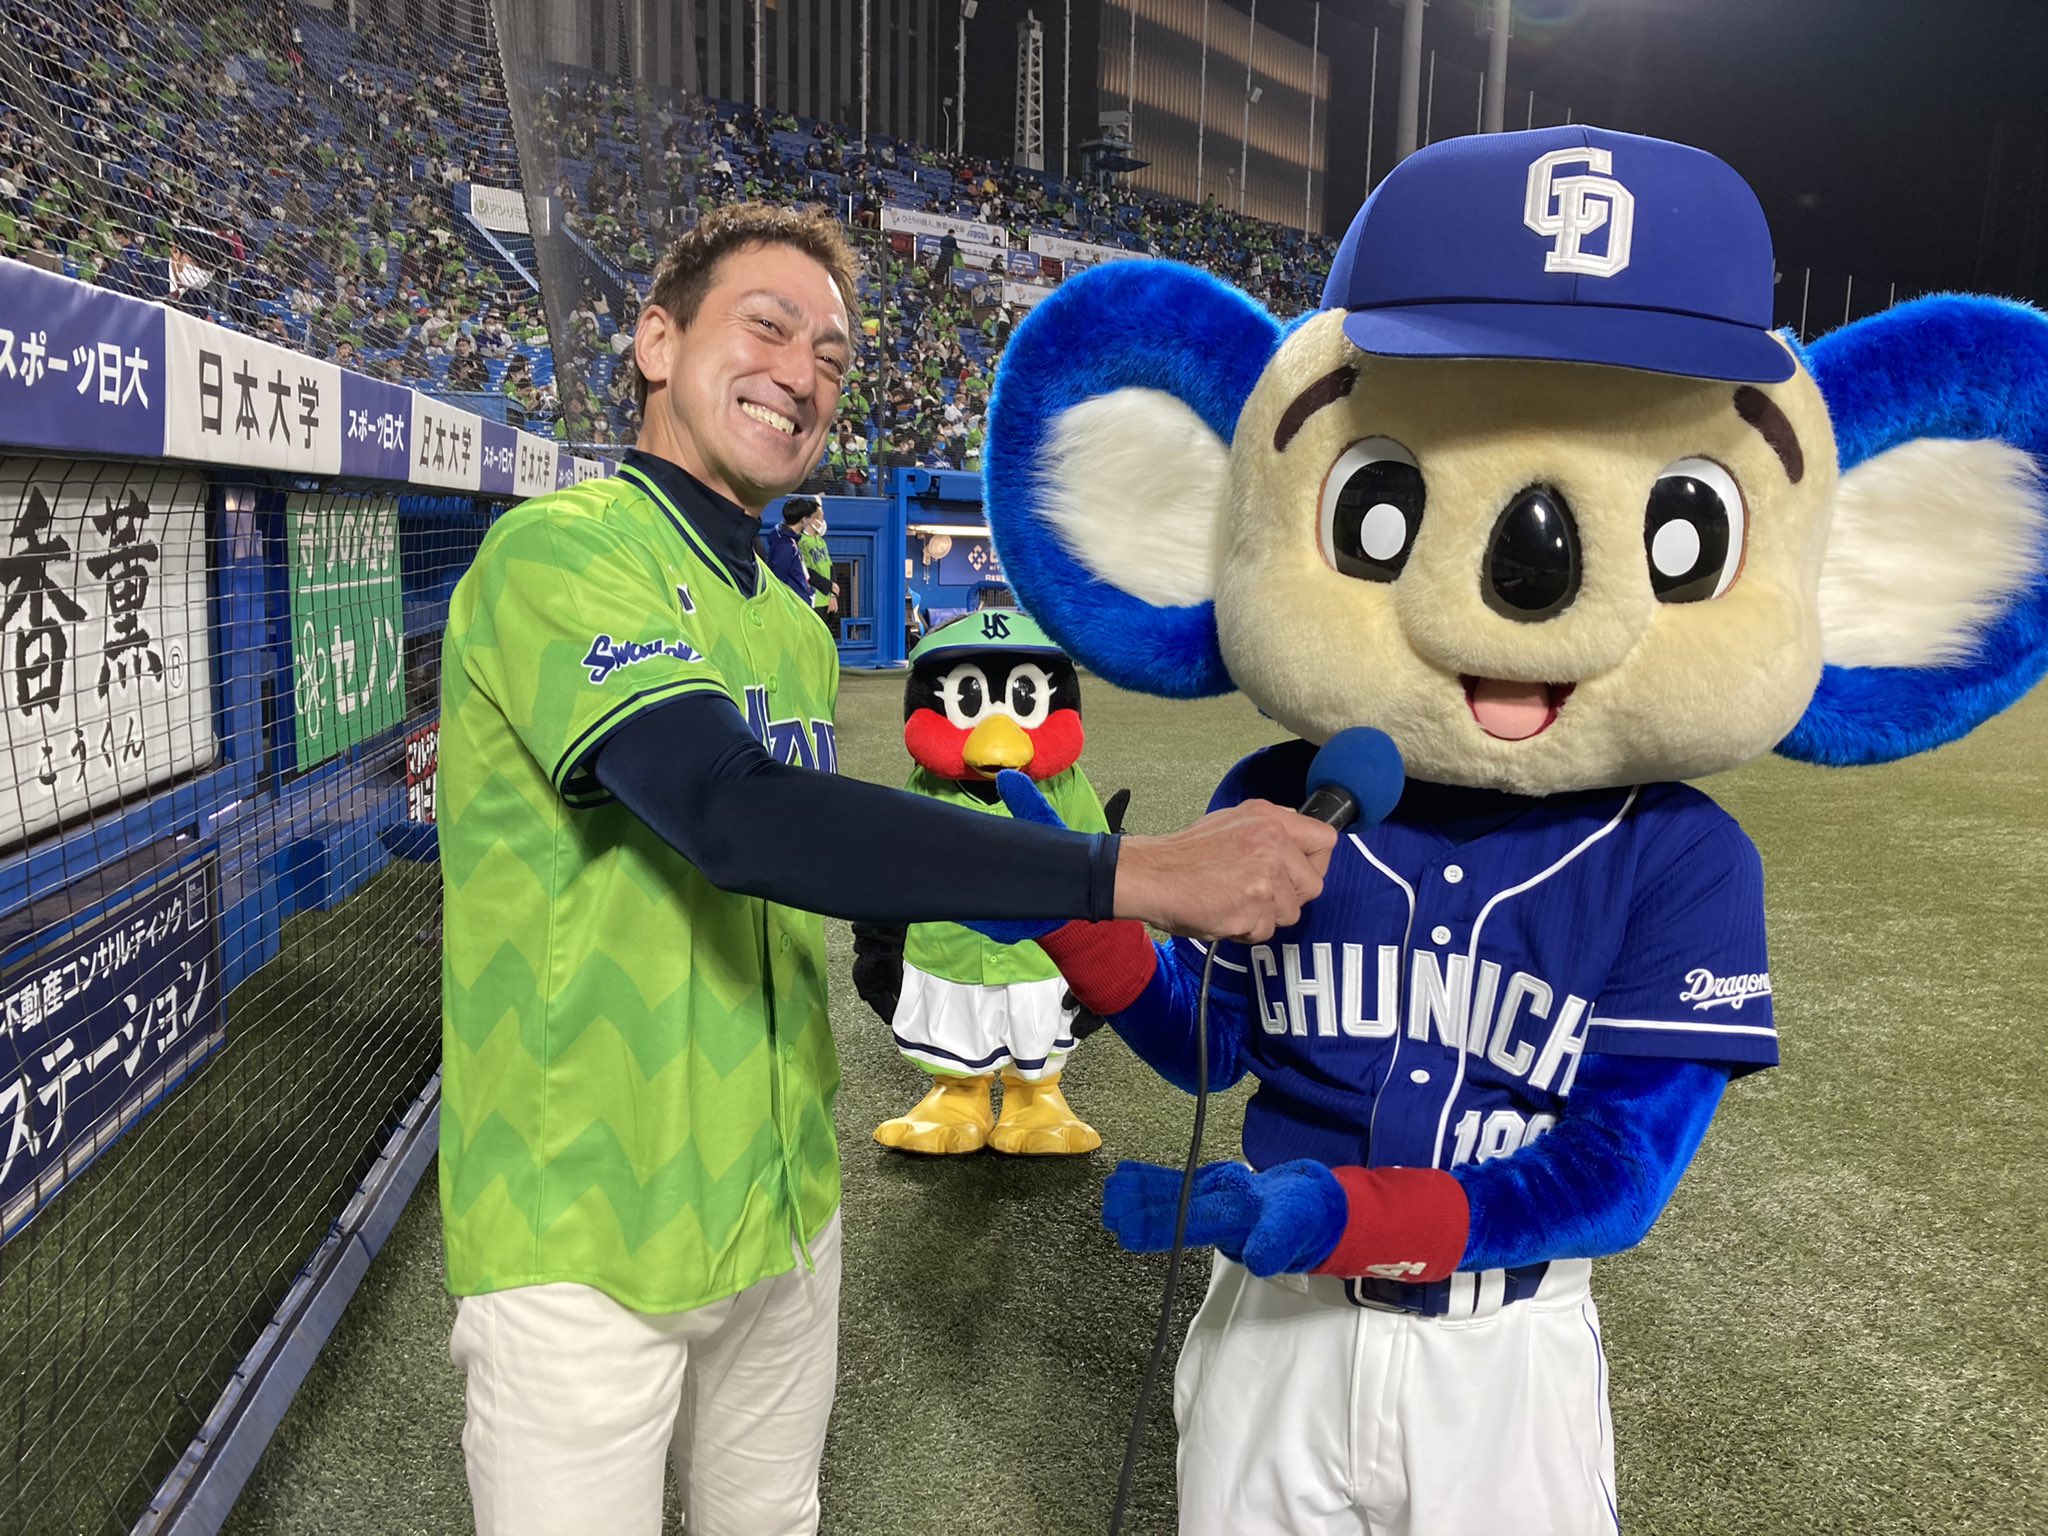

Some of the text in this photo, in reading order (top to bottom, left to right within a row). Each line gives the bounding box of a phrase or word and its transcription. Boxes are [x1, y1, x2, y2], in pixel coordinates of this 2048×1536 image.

[0, 328, 149, 410] スポーツ日大
[199, 349, 319, 449] 日本大学
[347, 408, 405, 452] スポーツ日大
[419, 414, 471, 476] 日本大学
[520, 444, 551, 489] 日本大学
